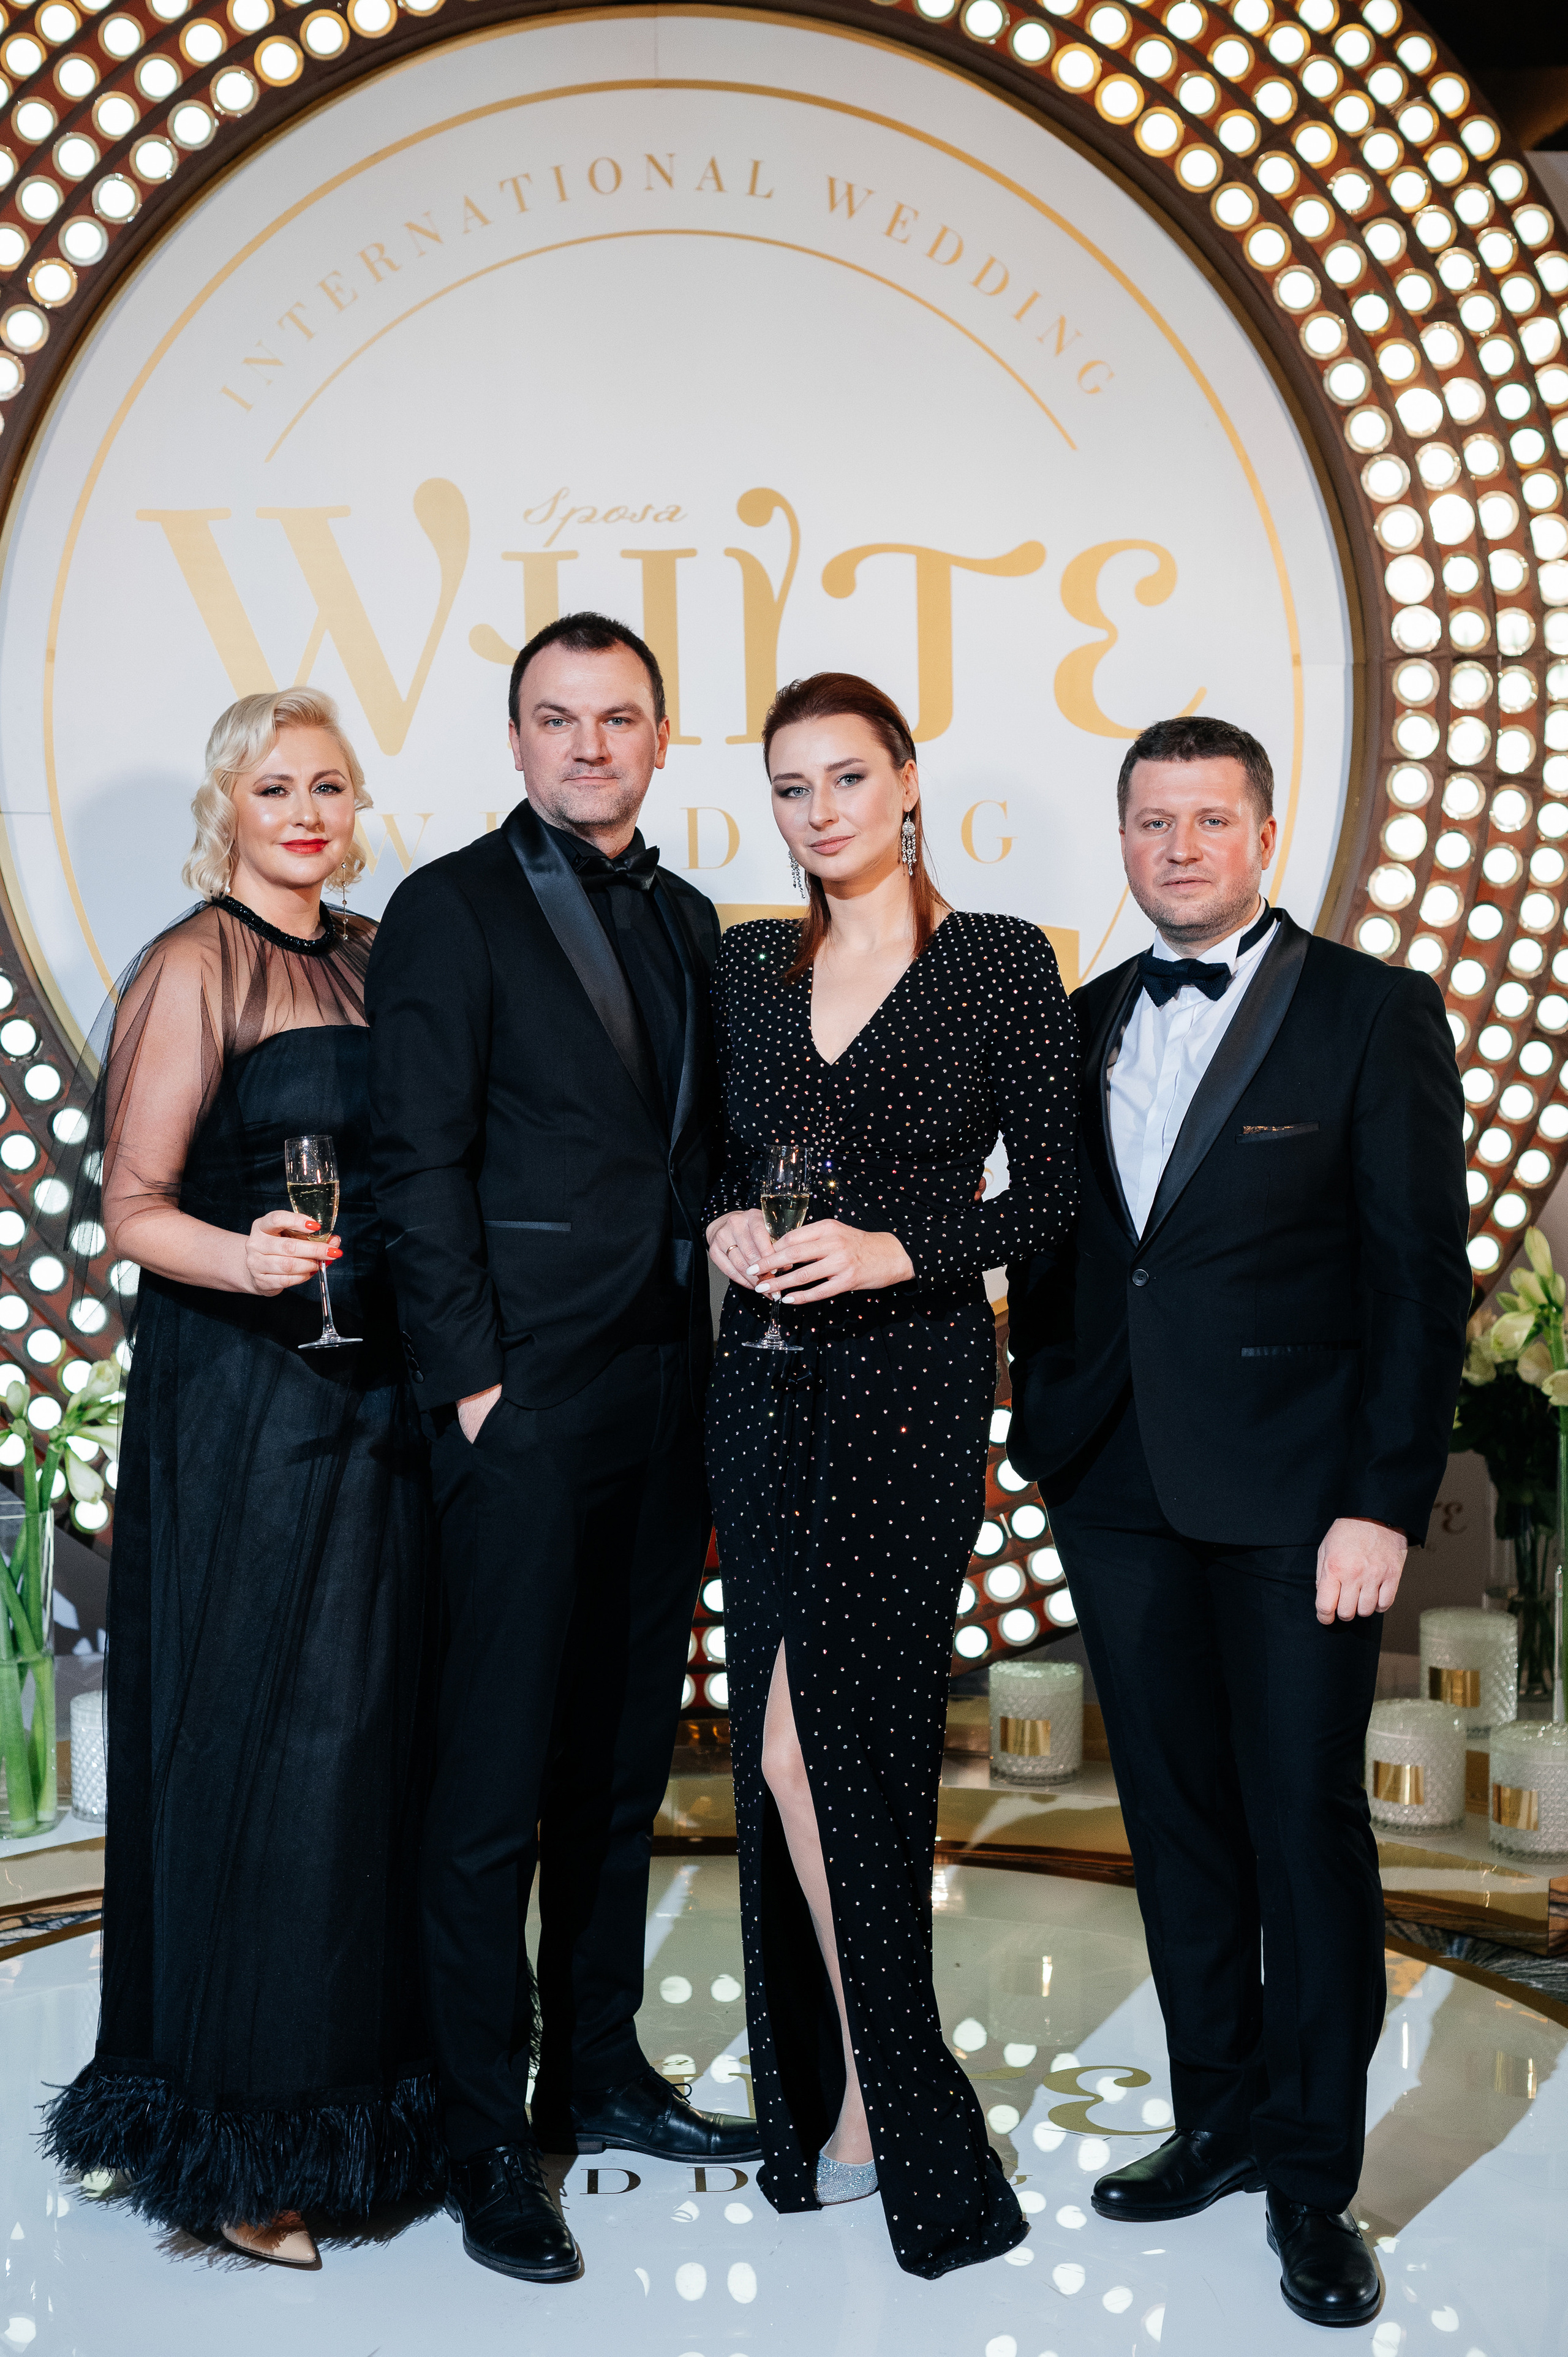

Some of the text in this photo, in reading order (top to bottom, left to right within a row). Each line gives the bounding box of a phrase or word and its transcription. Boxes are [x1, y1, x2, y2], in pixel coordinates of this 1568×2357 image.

[219, 152, 1115, 412] INTERNATIONAL WEDDING
[523, 486, 688, 548] Sposa
